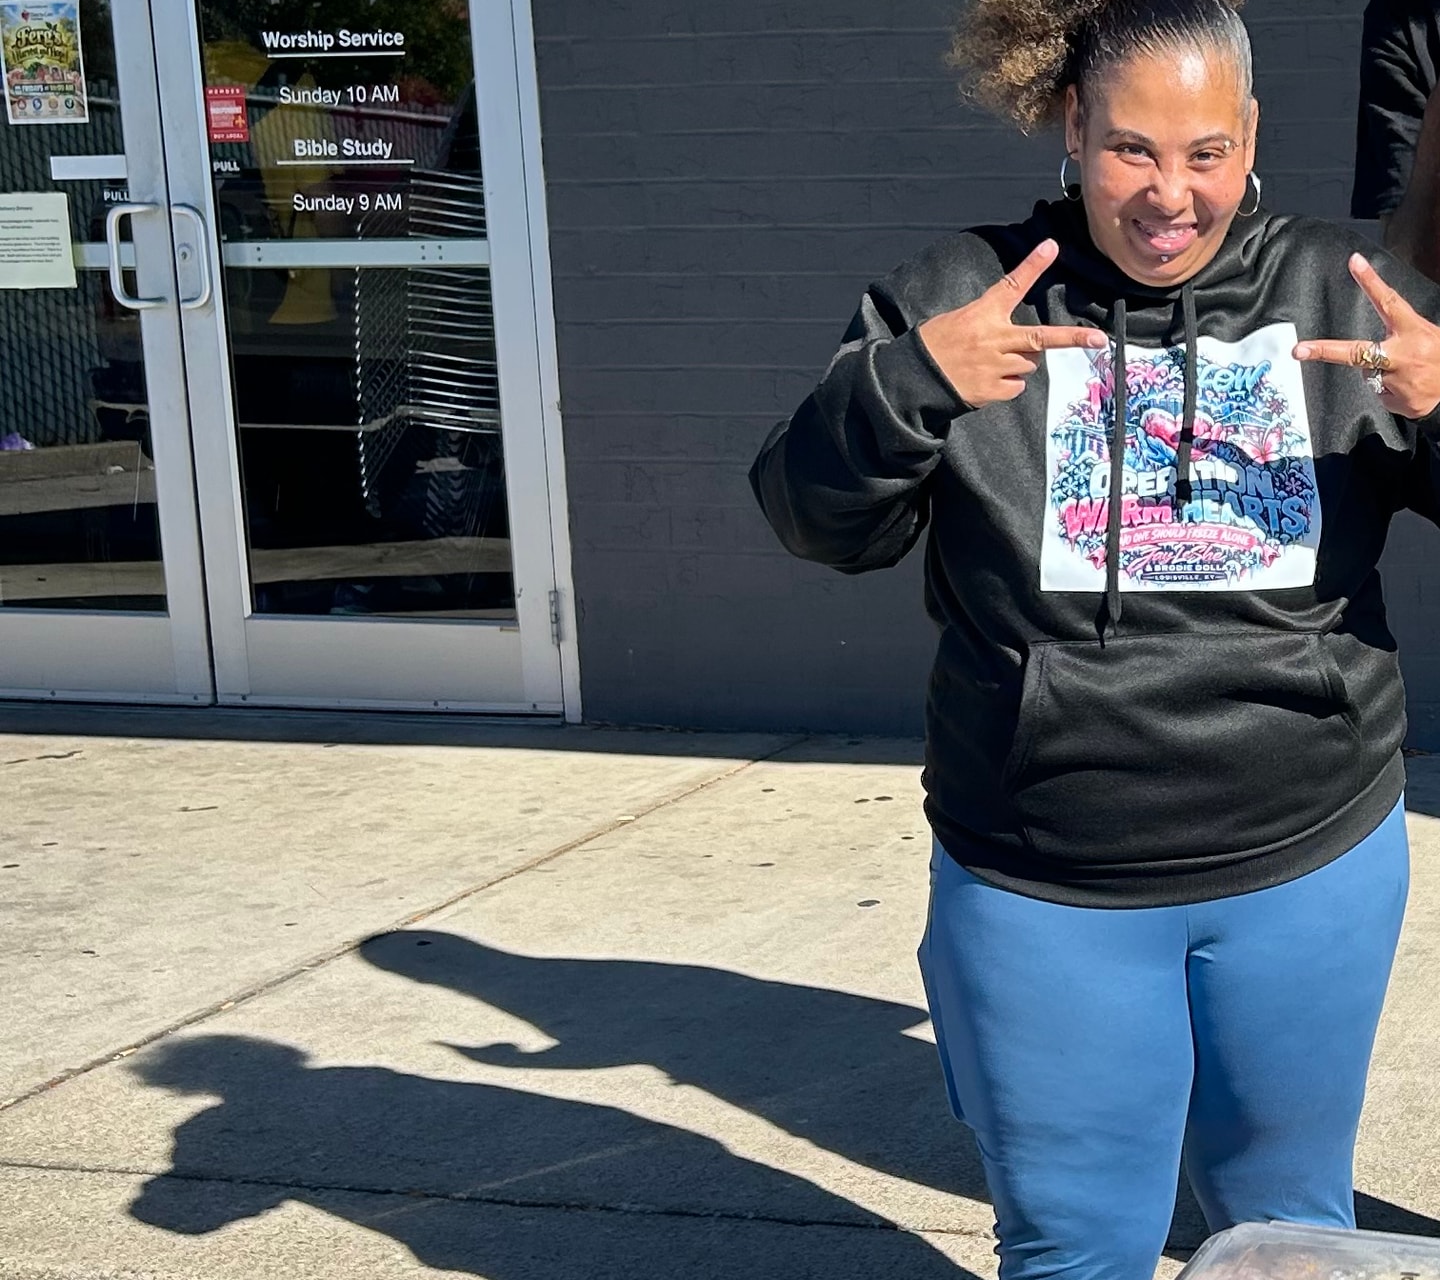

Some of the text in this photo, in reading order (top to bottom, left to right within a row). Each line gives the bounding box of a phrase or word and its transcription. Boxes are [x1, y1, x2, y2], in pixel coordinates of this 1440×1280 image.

[262, 29, 405, 50] Worship Service
[279, 85, 399, 106] Sunday 10 AM
[294, 138, 393, 158] Bible Study
[213, 161, 240, 172] PULL
[103, 190, 130, 201] PULL
[293, 193, 402, 215] Sunday 9 AM
[1182, 490, 1310, 535] HEARTS
[1133, 530, 1150, 544] ONE
[1152, 528, 1186, 541] SHOULD
[1187, 527, 1220, 540] FREEZE
[1220, 530, 1250, 546] ALONE
